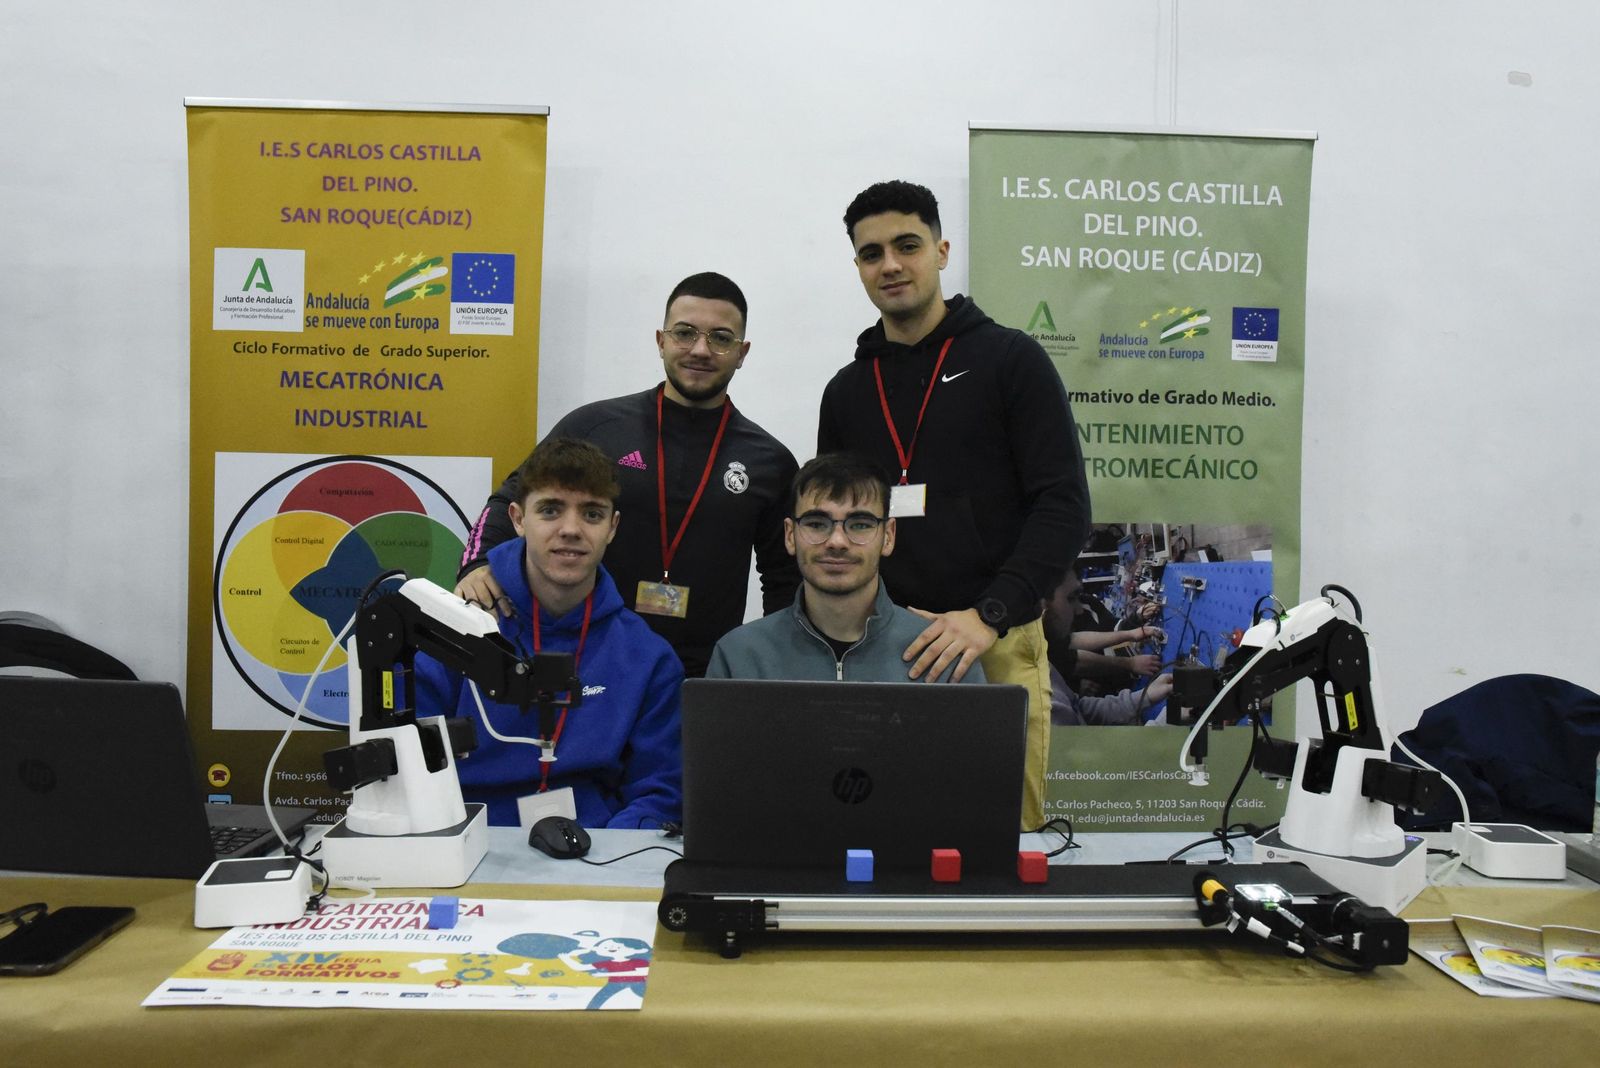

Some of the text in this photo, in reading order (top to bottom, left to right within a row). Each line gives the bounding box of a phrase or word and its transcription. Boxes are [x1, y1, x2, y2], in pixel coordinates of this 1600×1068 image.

[260, 142, 481, 161] I.E.S CARLOS CASTILLA
[322, 176, 418, 193] DEL PINO.
[1002, 177, 1283, 206] I.E.S. CARLOS CASTILLA
[281, 206, 472, 230] SAN ROQUE(CÁDIZ)
[1084, 213, 1203, 238] DEL PINO.
[1020, 245, 1262, 277] SAN ROQUE (CÁDIZ)
[223, 295, 293, 304] Junta de Andalucía
[306, 292, 369, 311] Andalucía
[456, 306, 508, 315] UNIÓN EUROPEA
[305, 313, 439, 334] se mueve con Europa
[1040, 333, 1076, 342] Andalucía
[1099, 333, 1148, 346] Andalucía
[233, 341, 490, 361] Ciclo Formativo de Grado Superior.
[1098, 347, 1205, 362] se mueve con Europa
[279, 368, 444, 391] MECATRÓNICA
[1068, 389, 1276, 407] rmativo de Grado Medio.
[294, 408, 427, 429] INDUSTRIAL
[1075, 423, 1244, 446] NTENIMIENTO
[618, 458, 647, 470] adidas
[1083, 454, 1258, 480] ROMECÁNICO
[319, 487, 374, 498] Computación
[274, 536, 325, 546] Control Digital
[229, 587, 262, 597] Control
[280, 637, 320, 645] Circuitos de
[280, 647, 305, 655] Control
[323, 689, 350, 698] Electro
[836, 768, 871, 803] hp
[274, 797, 301, 806] Avda.
[303, 796, 333, 806] Carlos
[1056, 799, 1088, 809] Carlos
[1090, 800, 1133, 811] Pacheco,
[1136, 800, 1144, 811] 5,
[1148, 800, 1177, 809] 11203
[1179, 799, 1198, 808] San
[1200, 799, 1234, 811] Roqu.
[1236, 798, 1266, 808] Cádiz.
[1044, 812, 1205, 824] 07791.edu@juntadeandalucia.es
[267, 932, 327, 941] CARLOS
[329, 932, 399, 941] CASTILLA
[404, 933, 431, 941] DEL
[436, 934, 473, 942] PINO
[229, 940, 303, 948] SAN ROQUE
[262, 951, 341, 964] XIV
[245, 969, 400, 978] FORMATIVOS
